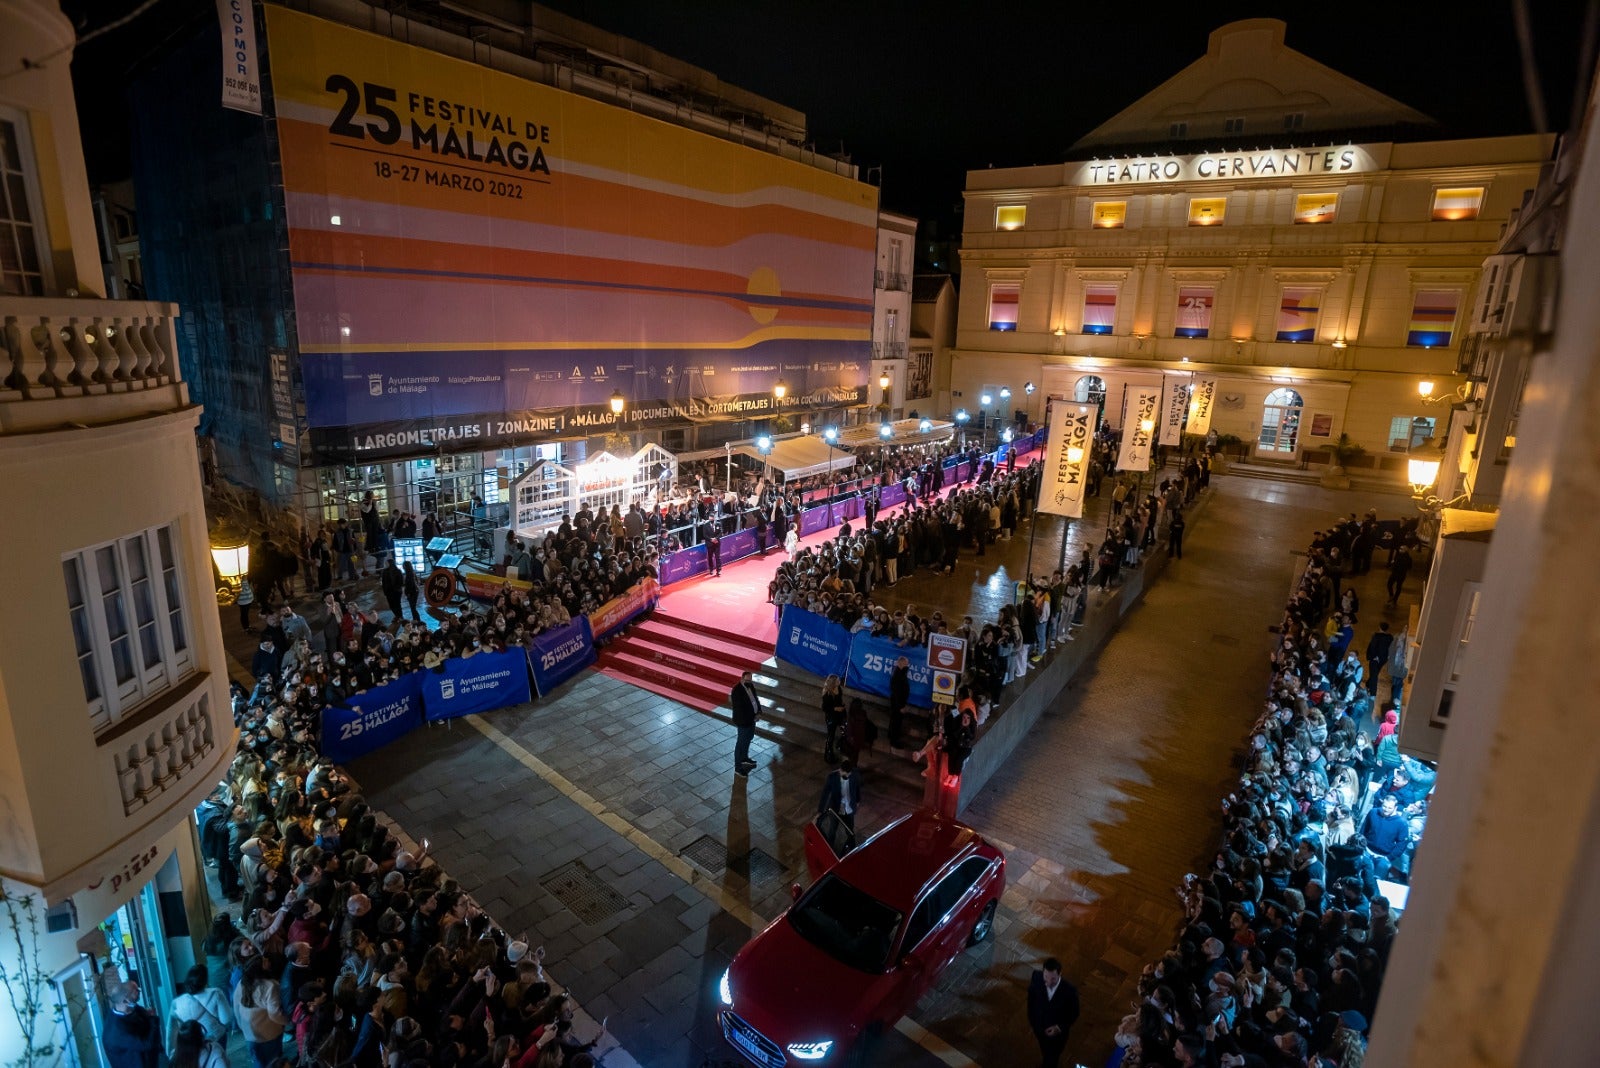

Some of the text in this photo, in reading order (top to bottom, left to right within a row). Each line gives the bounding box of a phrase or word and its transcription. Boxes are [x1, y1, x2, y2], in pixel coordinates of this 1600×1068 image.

[325, 74, 401, 145] 25
[409, 92, 551, 144] FESTIVAL DE
[411, 117, 551, 176] MÁLAGA
[1090, 150, 1354, 183] TEATRO CERVANTES
[374, 161, 523, 200] 18-27 MARZO 2022
[1184, 297, 1206, 313] 25
[387, 384, 427, 395] de Málaga
[388, 375, 440, 386] Ayuntamiento
[354, 424, 481, 451] LARGOMETRAJES
[497, 417, 556, 435] ZONAZINE
[631, 406, 699, 422] DOCUMENTALES
[708, 398, 768, 415] CORTOMETRAJES
[776, 395, 800, 407] CNEMA
[1138, 395, 1157, 446] MÁAGA
[1057, 412, 1075, 484] FESTIVAL DE
[1067, 415, 1089, 484] MÁAGA
[803, 632, 838, 652] Ayuntamiento
[809, 642, 828, 656] Málaga
[541, 649, 557, 671] 25
[863, 653, 883, 672] 25
[920, 666, 931, 675] DE
[460, 670, 511, 687] Ayuntamiento
[883, 664, 928, 685] MAGA
[460, 681, 499, 694] de Málaga
[364, 695, 410, 721] FESTIVAL DE
[365, 703, 410, 731] MÁLAGA
[340, 718, 363, 740] 25
